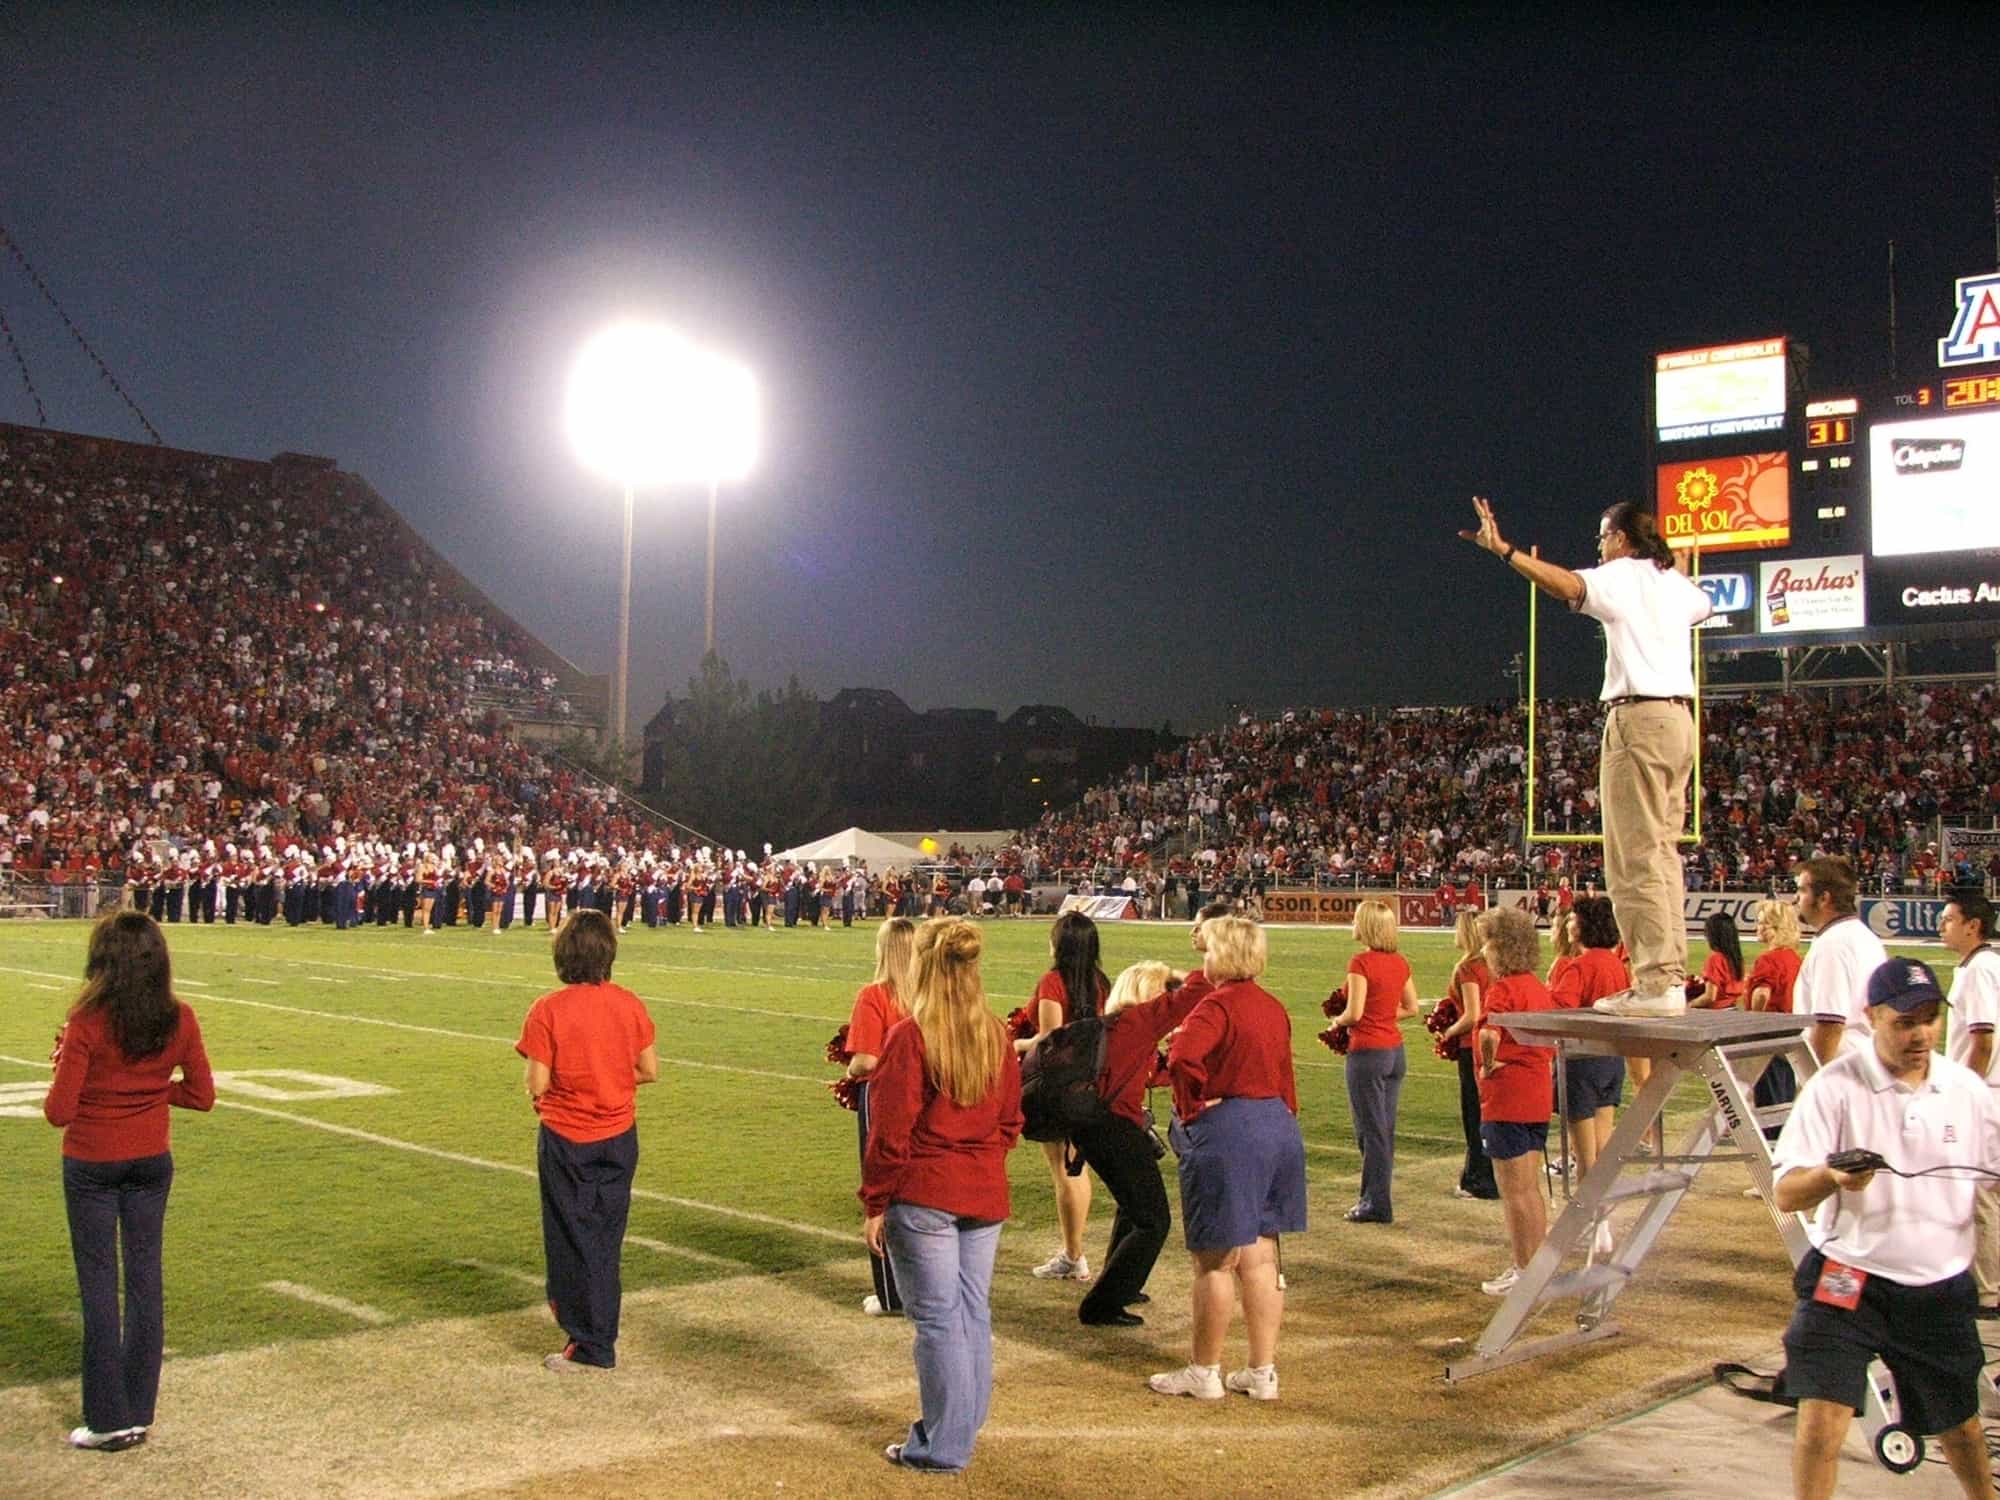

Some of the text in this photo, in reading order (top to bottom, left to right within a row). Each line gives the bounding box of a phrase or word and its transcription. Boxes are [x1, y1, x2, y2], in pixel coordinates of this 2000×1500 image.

[1917, 388, 1930, 405] 3
[1946, 378, 2000, 406] 20:
[1809, 420, 1846, 445] 31
[1665, 510, 1731, 535] DEL SOL
[1700, 578, 1737, 606] SN
[1768, 565, 1859, 593] Bashas'
[1902, 581, 2000, 607] Cactus Au
[1262, 896, 1363, 914] cson.com
[1711, 1080, 1741, 1130] JARVIS
